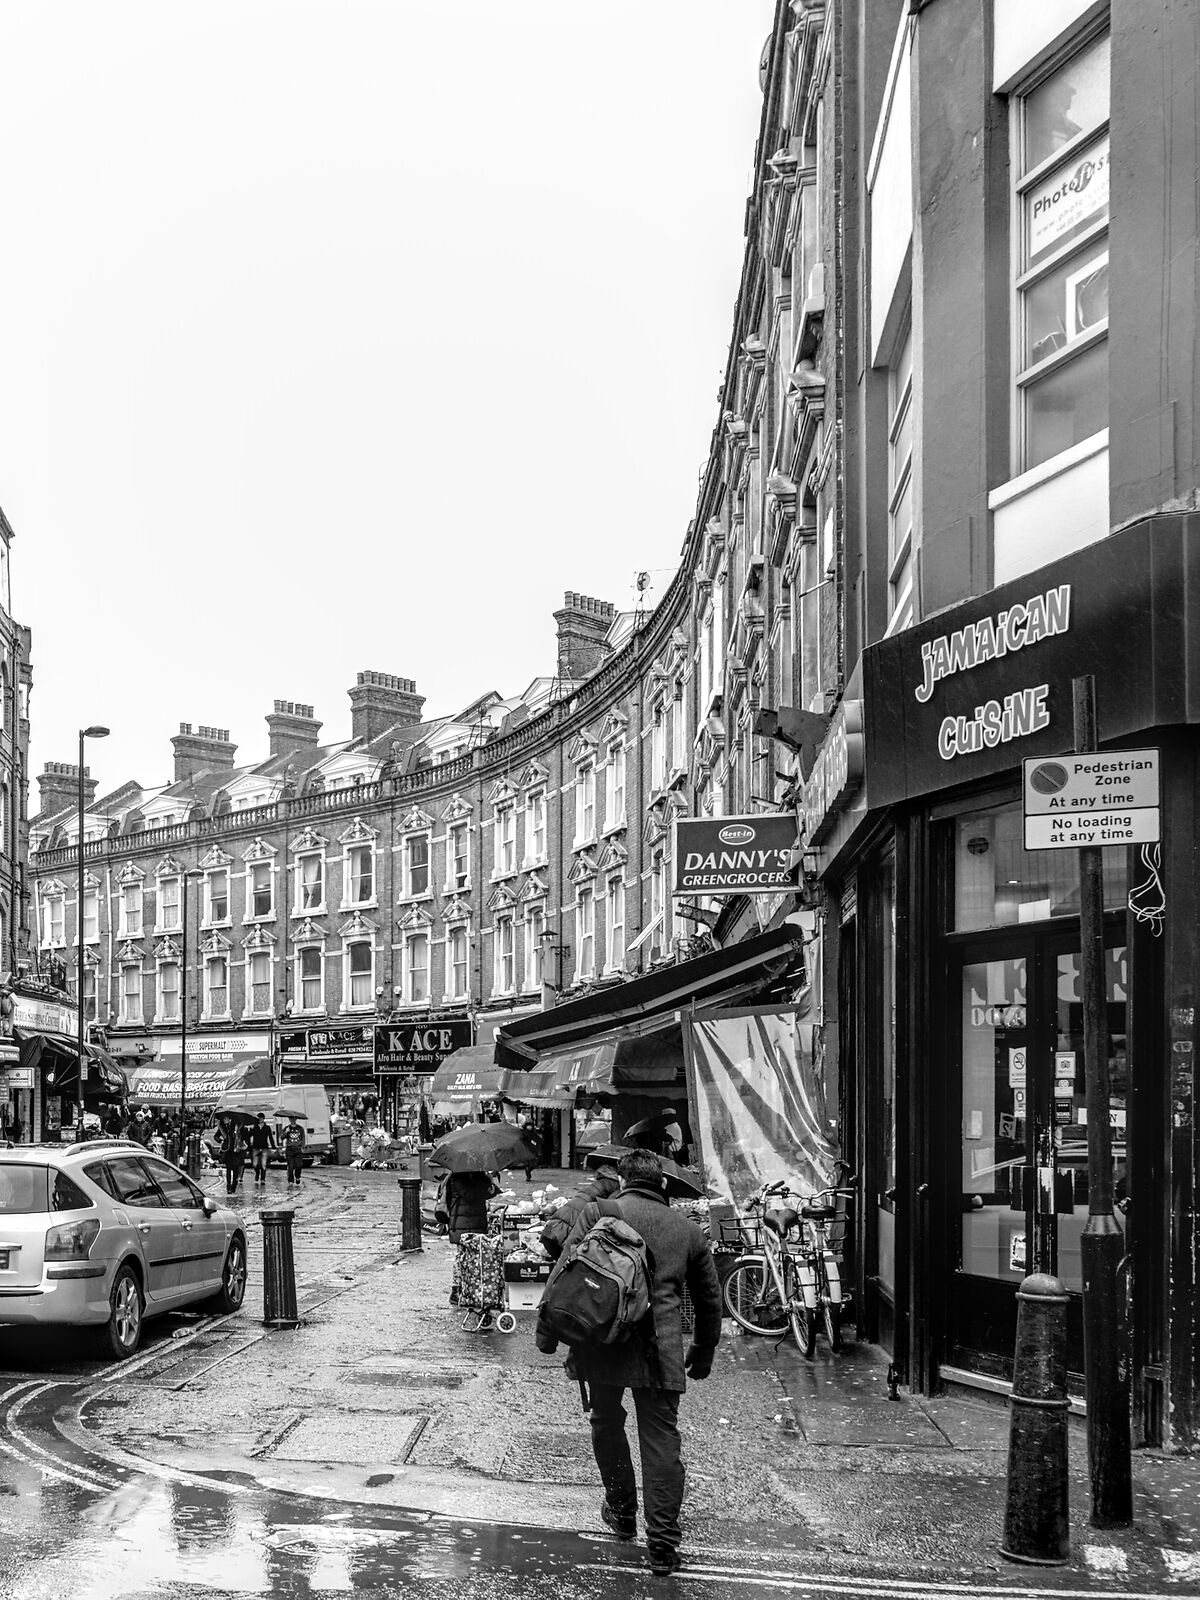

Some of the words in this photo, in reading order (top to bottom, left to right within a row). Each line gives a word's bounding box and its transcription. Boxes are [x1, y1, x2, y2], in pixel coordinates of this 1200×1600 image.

[1074, 760, 1153, 774] Pedestrian
[1095, 775, 1131, 786] Zone
[1049, 797, 1066, 808] At
[1071, 797, 1097, 807] any
[1102, 794, 1135, 804] time
[1052, 819, 1072, 829] No
[1078, 816, 1132, 828] loading
[1050, 833, 1065, 842] at
[1070, 832, 1095, 842] any
[1101, 829, 1134, 839] time
[683, 848, 792, 870] DANNY'S
[682, 872, 793, 887] GREENGROCERS
[198, 1041, 227, 1051] SUPERMALT
[409, 1029, 453, 1051] ACE
[377, 1053, 390, 1062] Afro
[390, 1053, 405, 1062] Hair
[405, 1053, 412, 1061] &
[413, 1052, 434, 1063] Beauty
[137, 1082, 161, 1092] FOOD
[186, 1081, 227, 1092] BRIXTON
